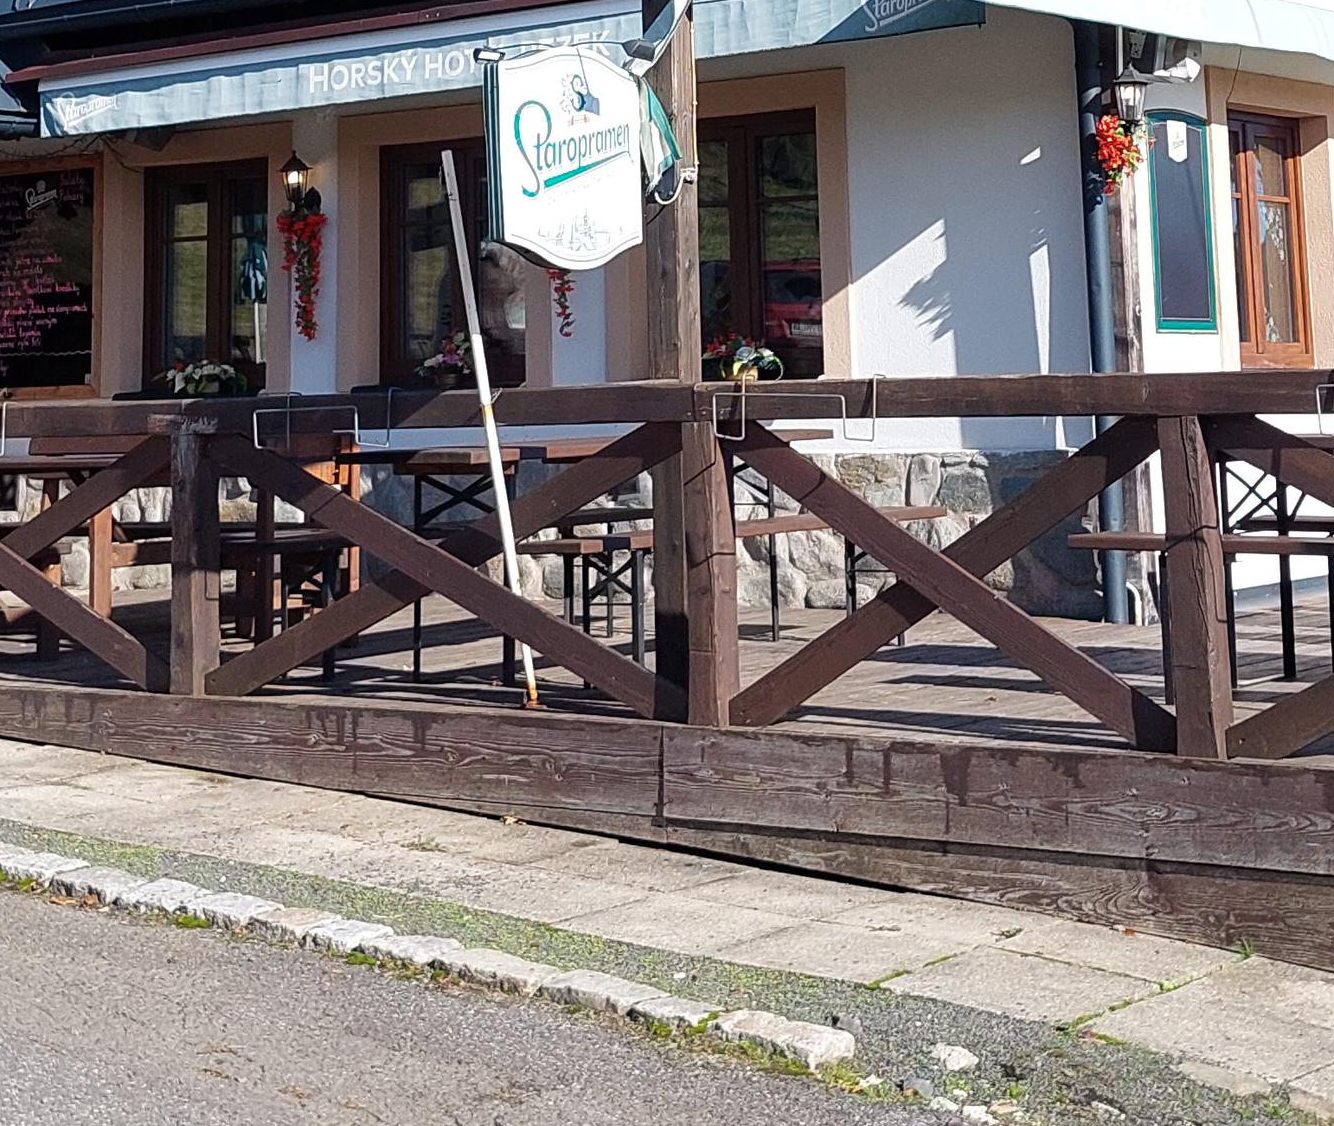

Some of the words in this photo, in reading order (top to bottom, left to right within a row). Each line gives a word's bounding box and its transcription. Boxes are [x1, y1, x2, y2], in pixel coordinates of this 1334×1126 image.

[308, 49, 418, 94] HORSKÝ
[424, 46, 479, 82] HOT
[513, 100, 633, 197] Staropramen
